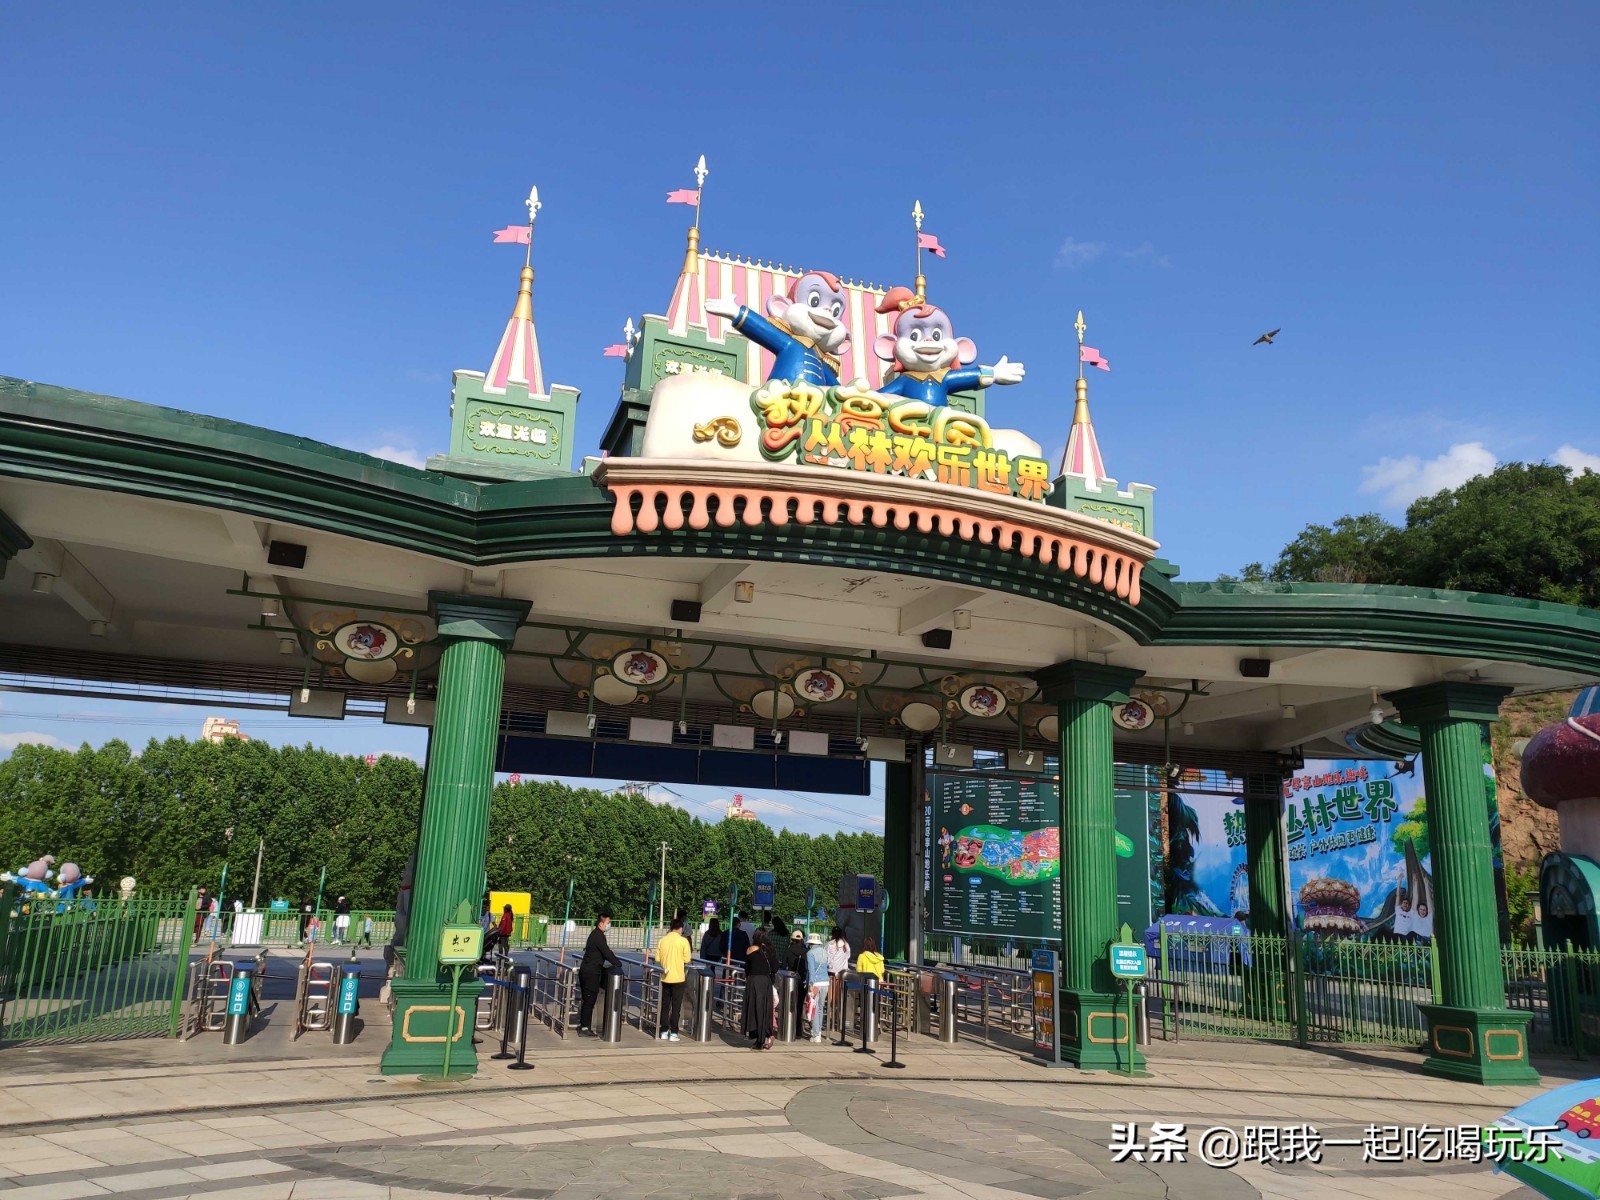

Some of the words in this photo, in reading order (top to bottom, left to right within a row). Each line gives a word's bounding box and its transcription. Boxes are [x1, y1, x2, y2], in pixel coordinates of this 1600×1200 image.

[479, 420, 548, 445] 欢迎光临
[803, 419, 1051, 500] 丛林欢乐世界
[452, 934, 471, 946] 出口
[233, 992, 243, 1012] 出口
[343, 991, 354, 1011] 出口
